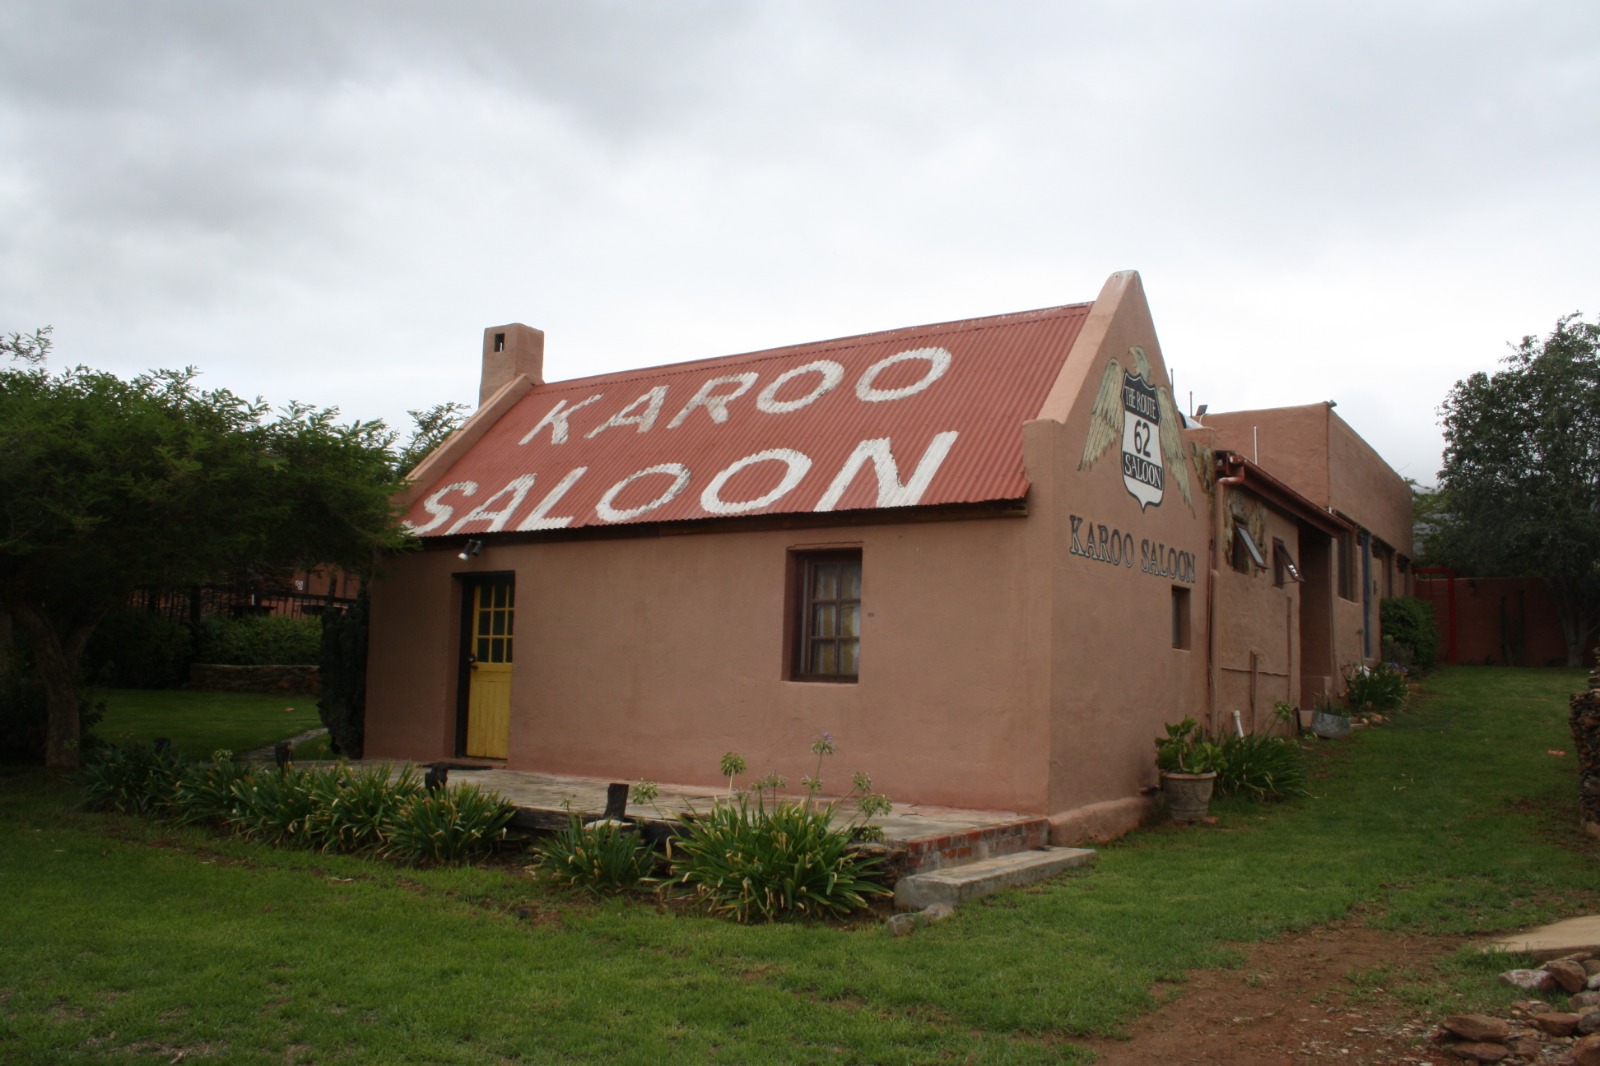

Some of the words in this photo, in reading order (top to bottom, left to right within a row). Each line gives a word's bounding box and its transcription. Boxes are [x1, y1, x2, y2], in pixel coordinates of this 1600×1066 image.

[518, 347, 952, 446] KAROO
[1125, 386, 1135, 408] THE
[1137, 393, 1156, 419] ROUTE
[1134, 419, 1151, 458] 62
[402, 431, 959, 537] SALOON
[1125, 454, 1161, 488] SALOON
[1069, 514, 1134, 568] KAROO
[1141, 538, 1196, 583] SALOON
